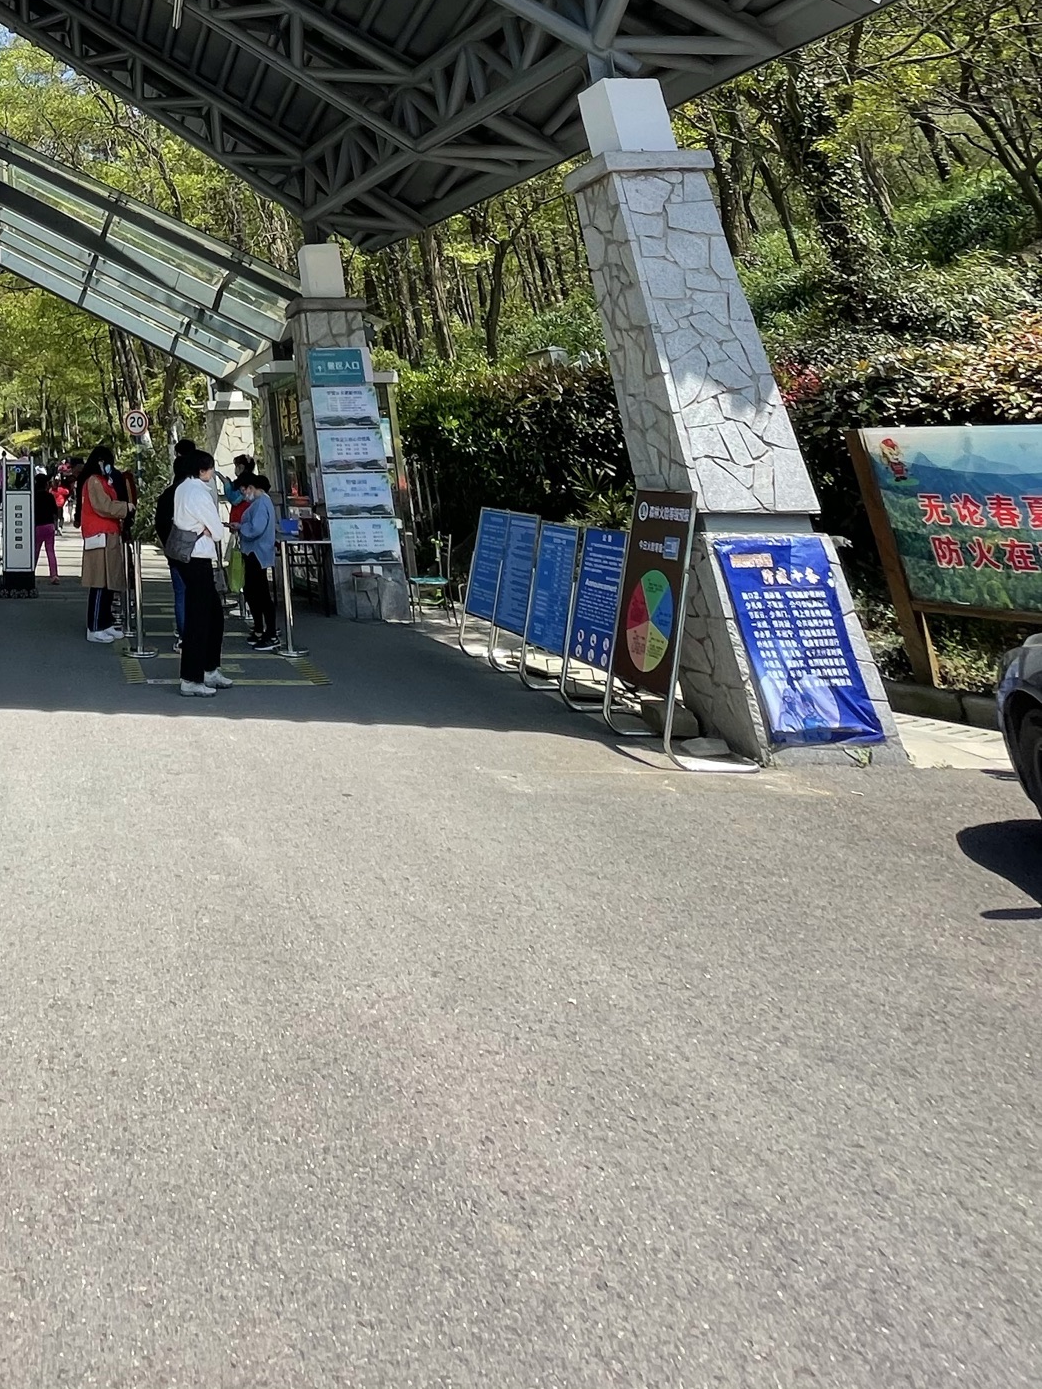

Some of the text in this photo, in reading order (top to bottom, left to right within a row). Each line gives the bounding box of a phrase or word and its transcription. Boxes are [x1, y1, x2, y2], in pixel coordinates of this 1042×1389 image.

[129, 416, 144, 428] 20
[917, 493, 1042, 530] 无论春夏
[930, 534, 1042, 573] 防火在
